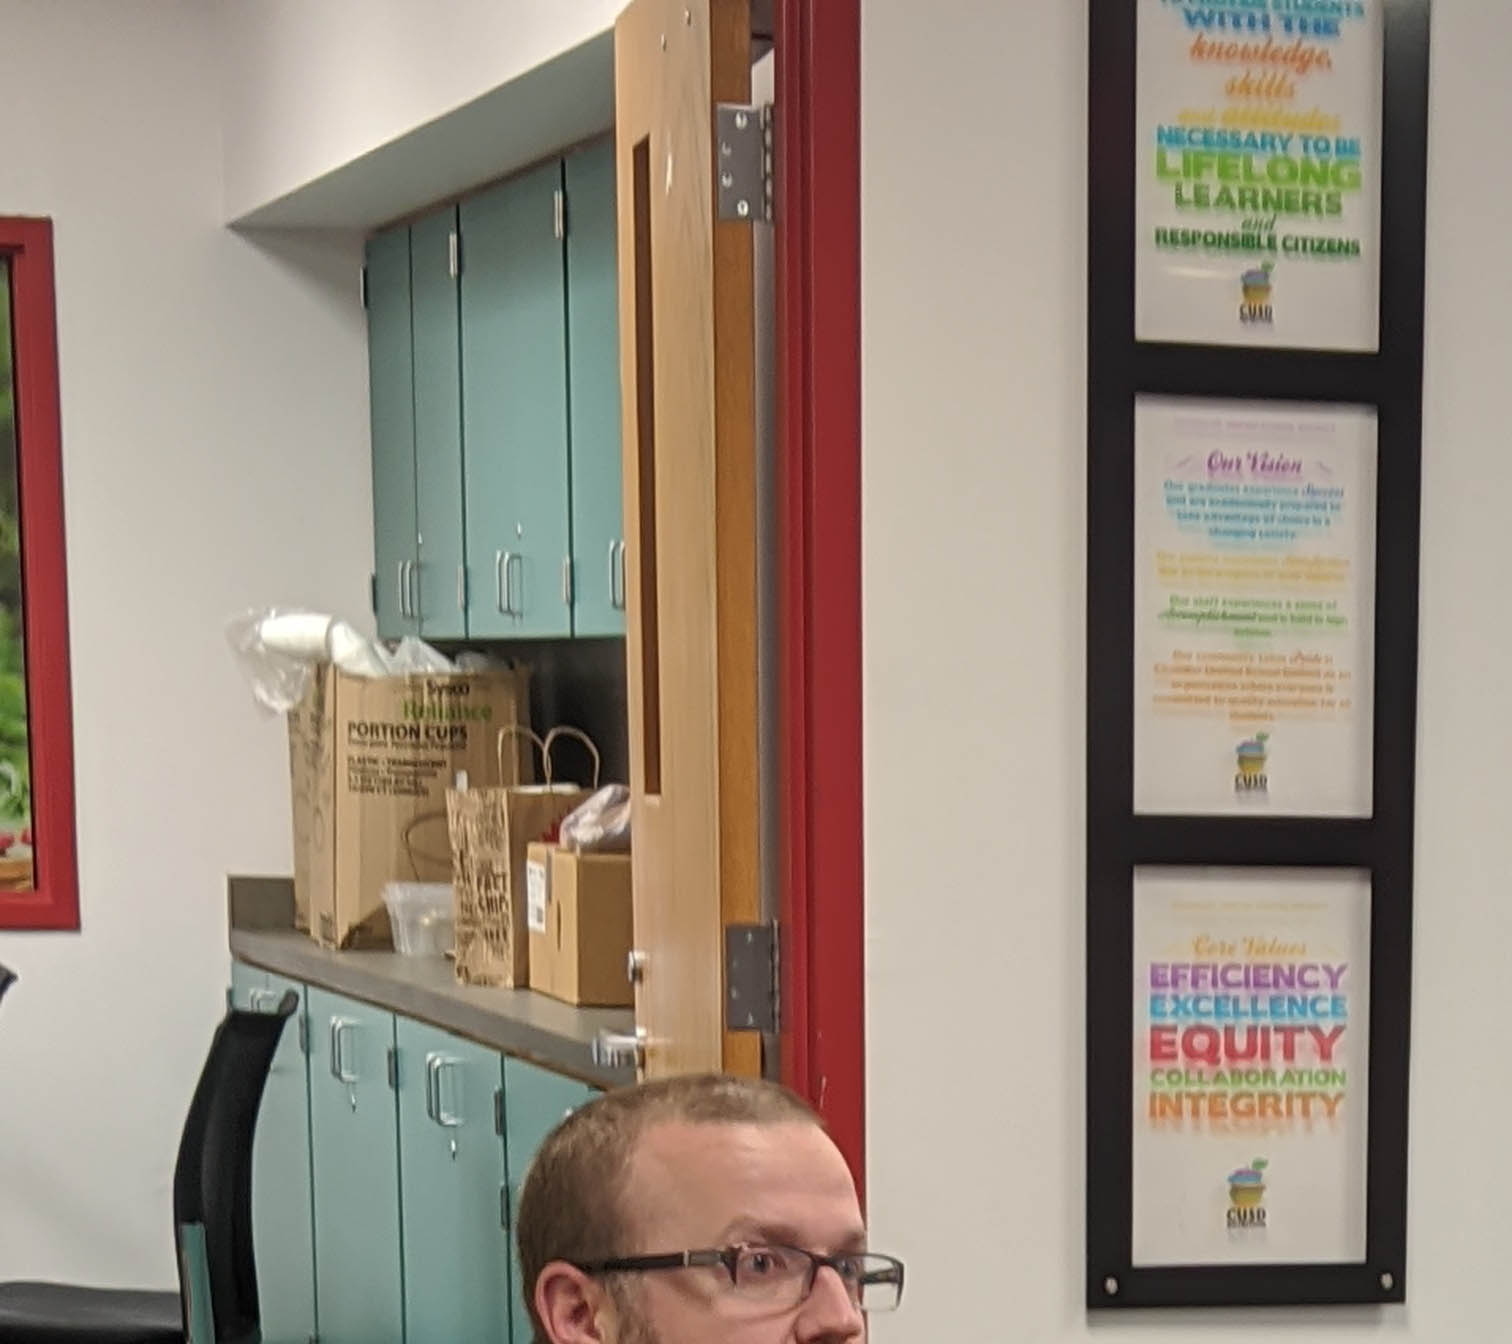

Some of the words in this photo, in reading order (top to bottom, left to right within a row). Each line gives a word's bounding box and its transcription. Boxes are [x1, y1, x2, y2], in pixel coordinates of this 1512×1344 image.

[1183, 8, 1270, 33] WITH
[1281, 14, 1340, 37] THE
[1156, 124, 1291, 154] NECESSARY
[1298, 134, 1330, 155] TO
[1156, 148, 1362, 189] LIFELONG
[1174, 181, 1343, 215] LEARNERS
[1241, 214, 1276, 232] and
[1155, 227, 1278, 252] RESPONSIBLE
[1281, 234, 1361, 256] CITIZENS
[1206, 450, 1242, 475] Our
[1246, 451, 1304, 474] Vision
[347, 720, 421, 741] PORTION
[424, 725, 468, 743] CUPS
[1149, 962, 1349, 990] EFFICIENCY
[1148, 993, 1349, 1019] EXCELLENCE
[1148, 1024, 1347, 1067] EQUITY
[1148, 1067, 1348, 1087] COLLABORATION
[1148, 1091, 1347, 1120] INTEGRITY
